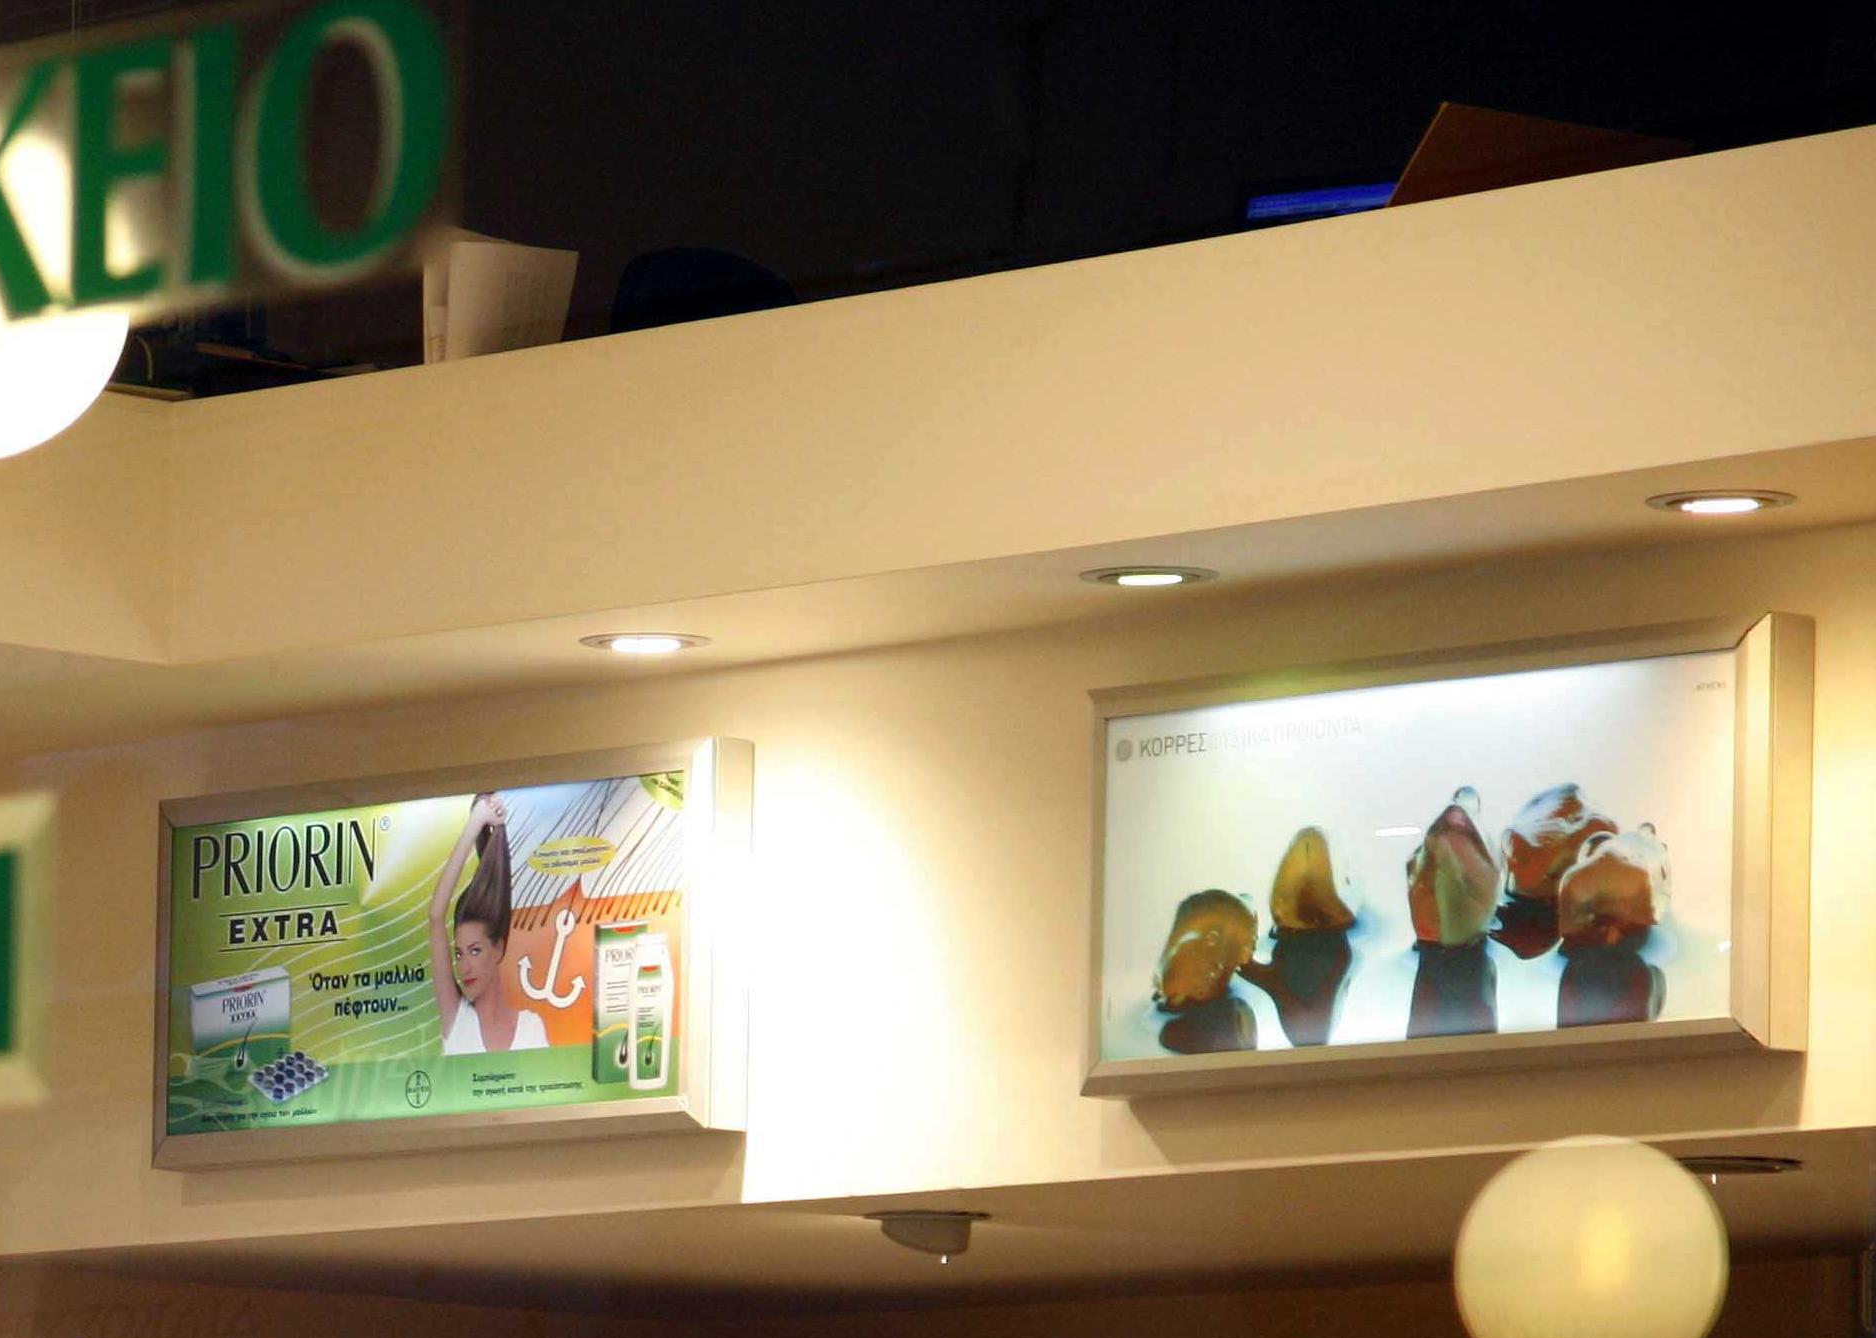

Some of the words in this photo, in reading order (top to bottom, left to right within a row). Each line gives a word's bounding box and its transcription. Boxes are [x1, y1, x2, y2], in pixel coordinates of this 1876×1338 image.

[1139, 732, 1208, 758] ΚΟΡΡΕΣ
[191, 816, 377, 899] PRIORIN
[228, 910, 340, 945] EXTRA
[352, 970, 370, 988] τα
